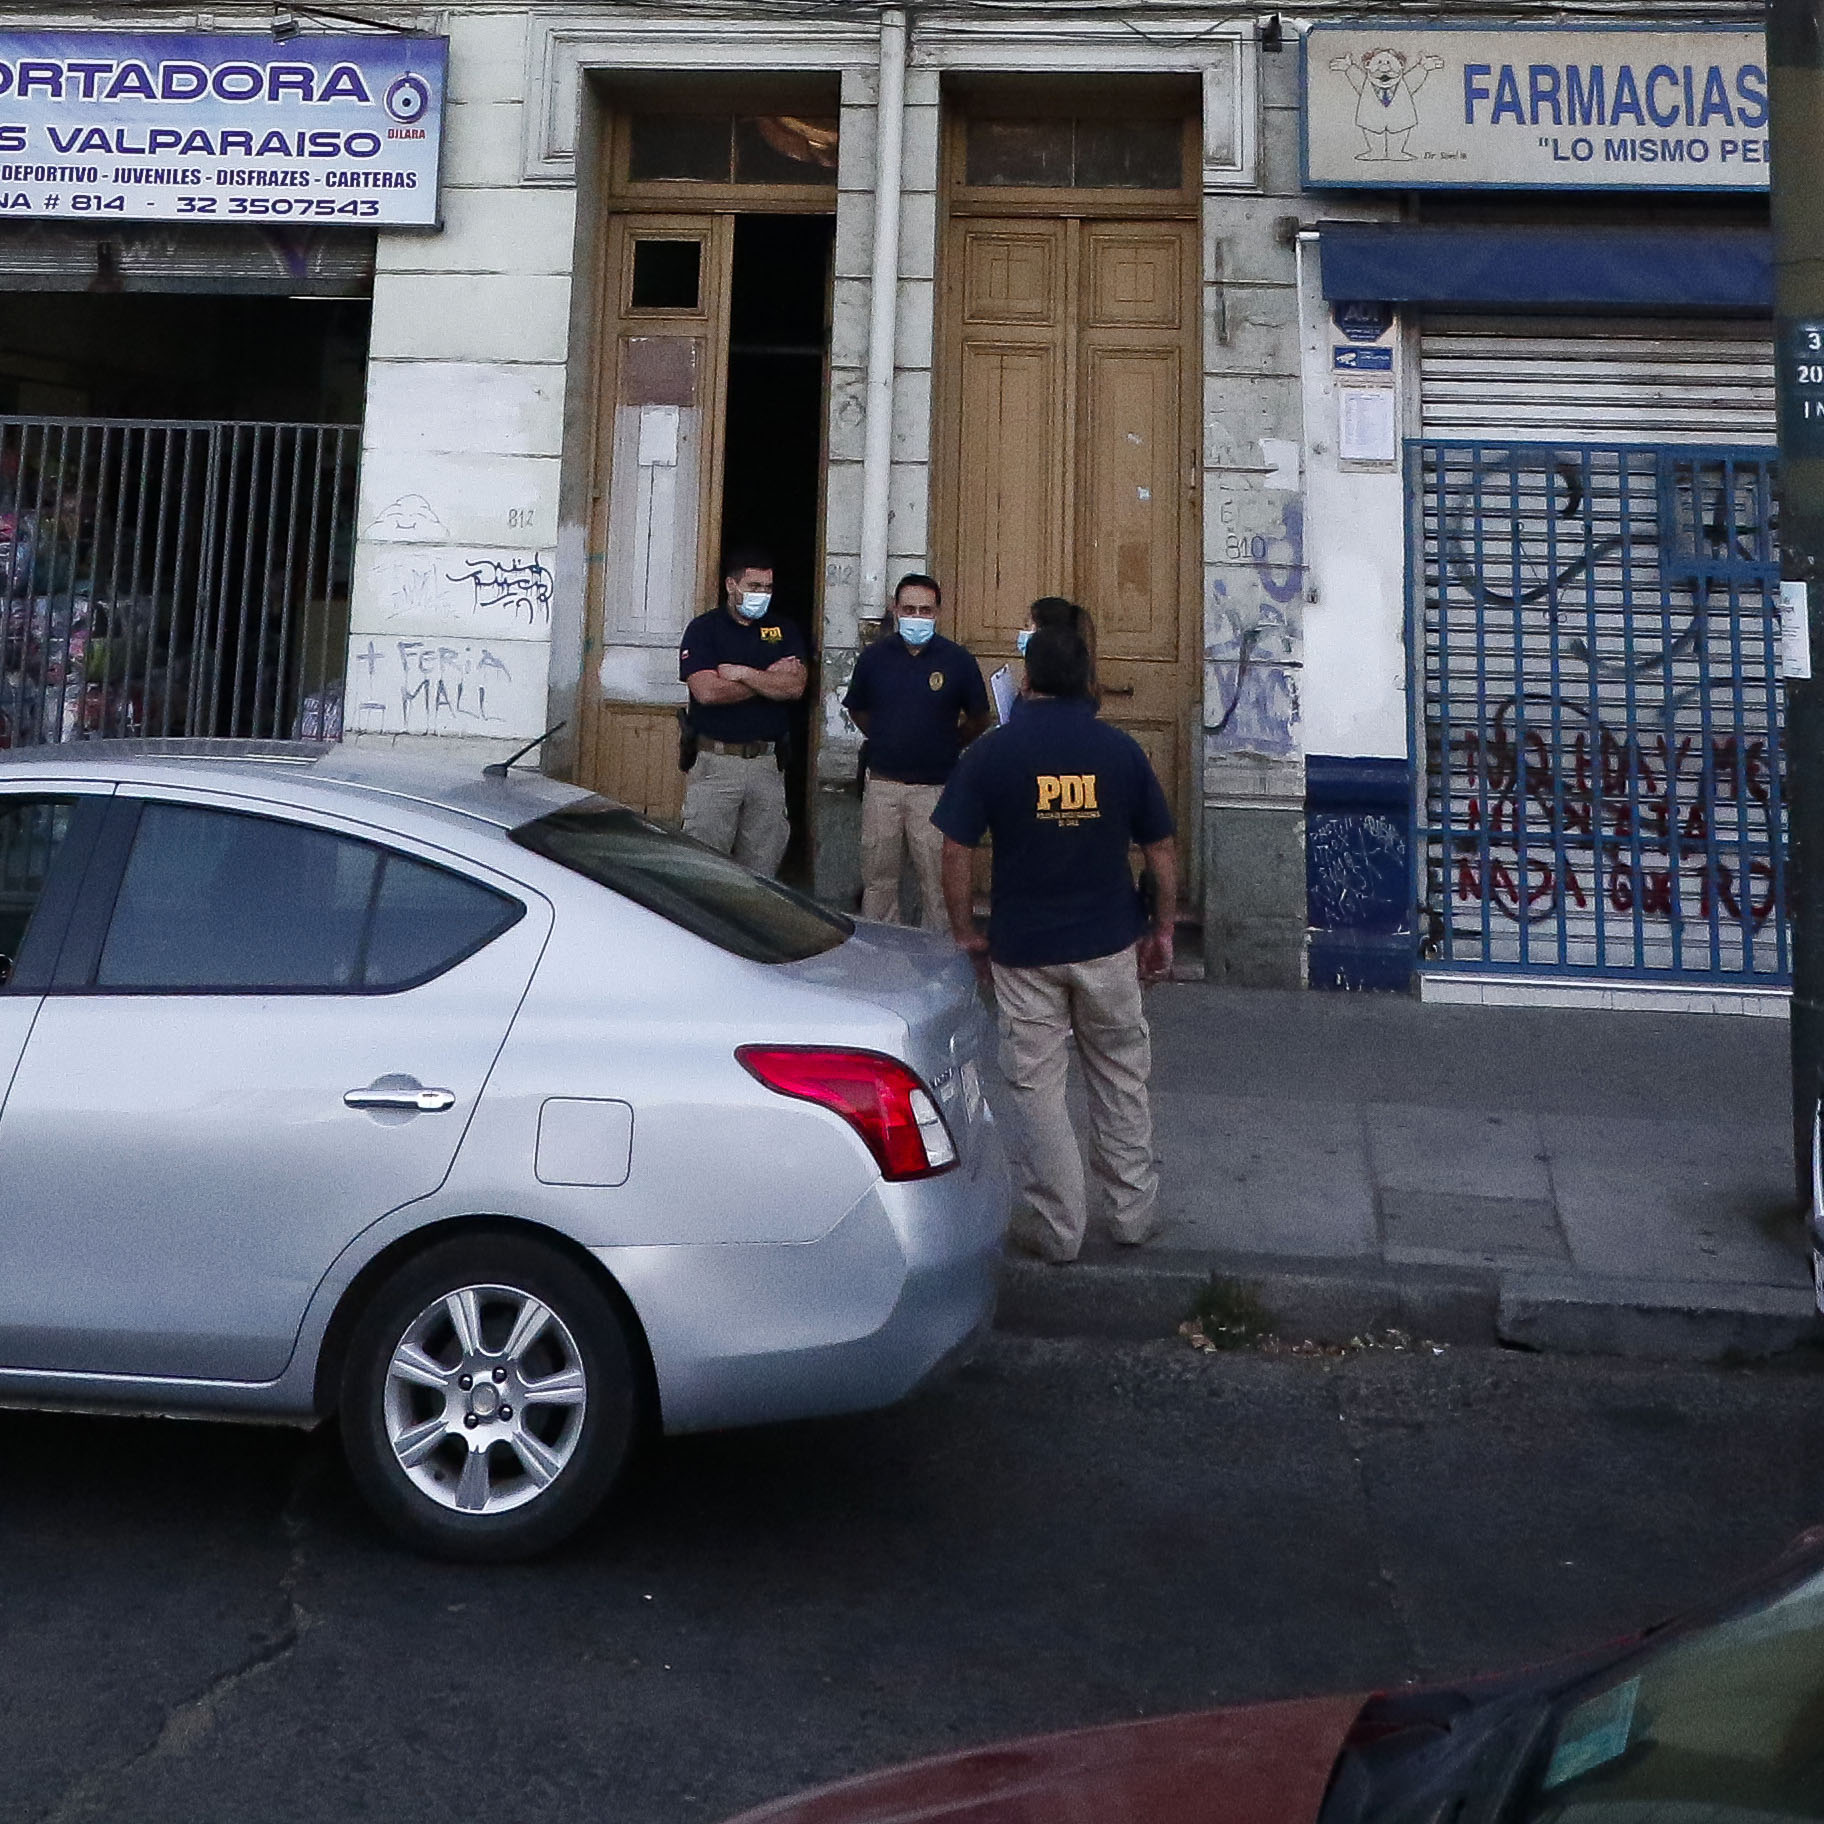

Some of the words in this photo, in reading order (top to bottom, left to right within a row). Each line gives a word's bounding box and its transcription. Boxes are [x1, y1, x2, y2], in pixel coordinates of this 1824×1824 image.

[1463, 63, 1769, 128] FARMACIAS
[47, 124, 383, 159] VALPARAISO
[1604, 138, 1709, 163] MISMO
[1720, 138, 1771, 164] PE
[1, 163, 98, 184] DEPORTIVO
[111, 165, 201, 186] JUVENILES
[215, 168, 310, 188] DISFRAZES
[325, 170, 418, 189] CARTERAS
[71, 194, 125, 212] 814
[176, 196, 217, 214] 32
[227, 197, 380, 217] 3507543
[1225, 534, 1267, 560] 810
[759, 626, 784, 638] PDI
[401, 678, 507, 723] MALL
[1036, 774, 1098, 811] PDI
